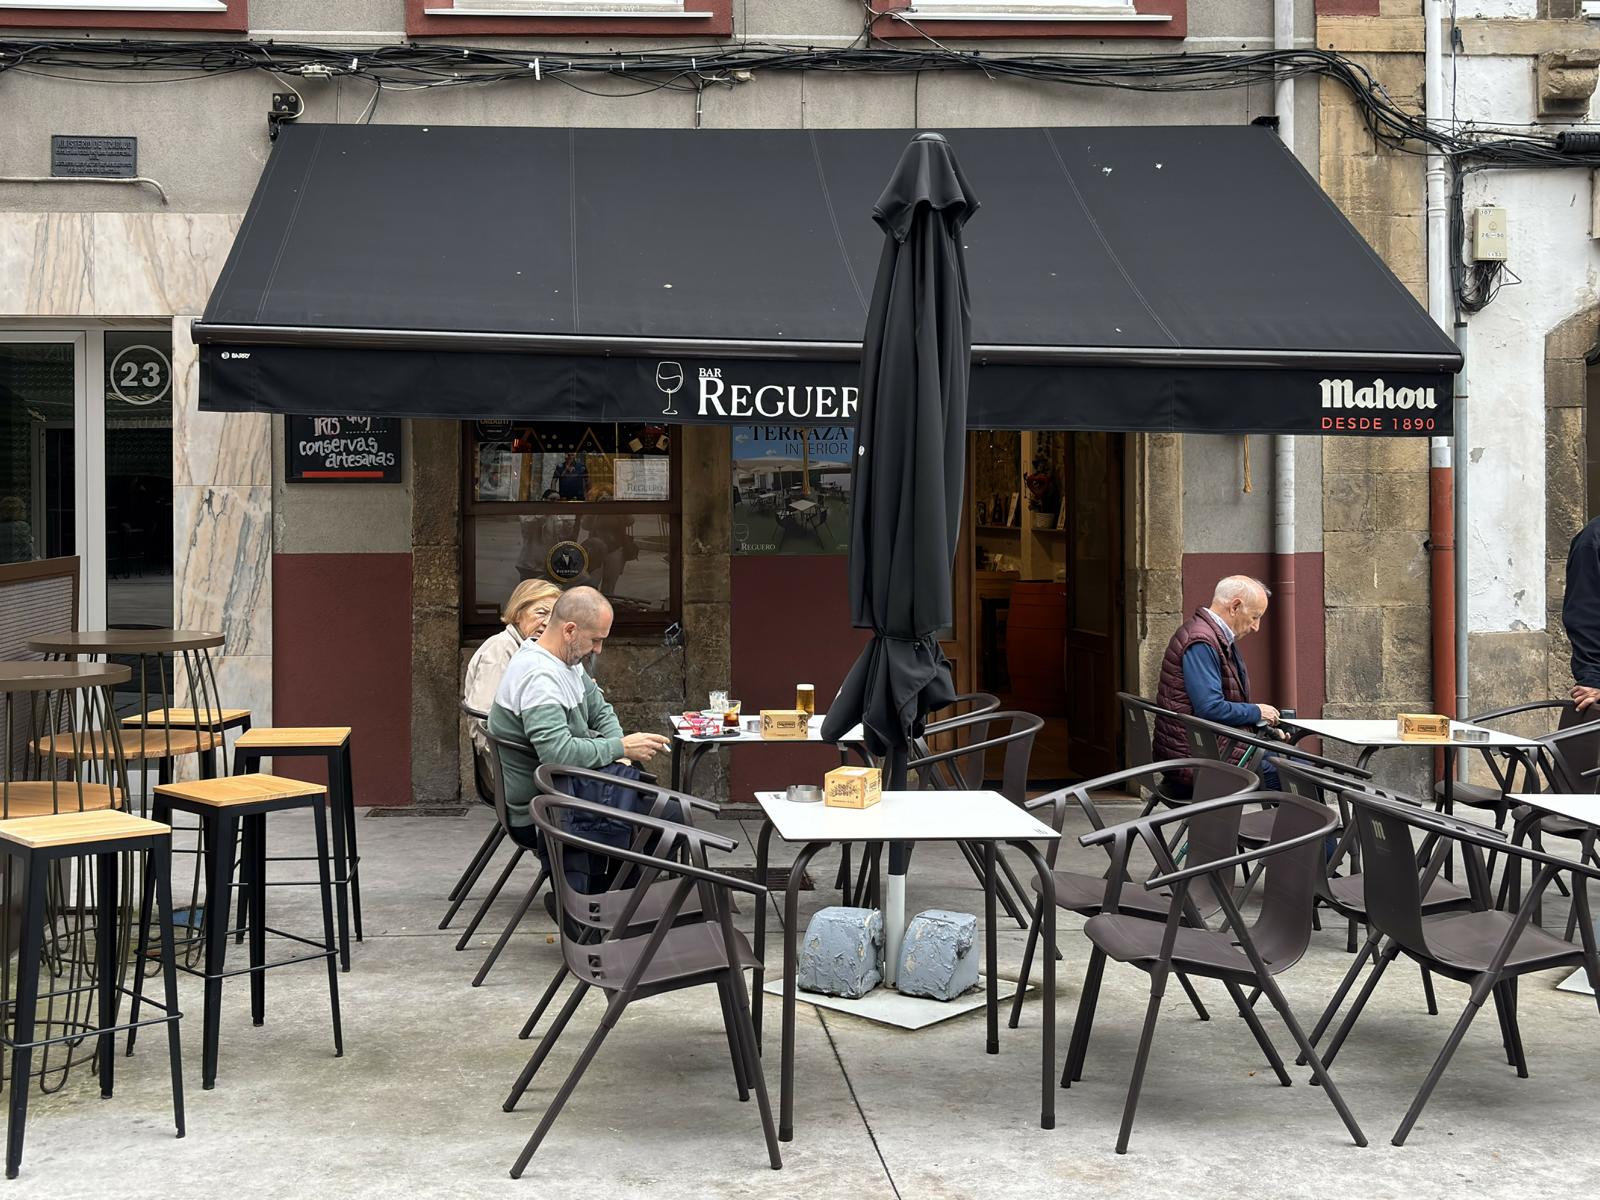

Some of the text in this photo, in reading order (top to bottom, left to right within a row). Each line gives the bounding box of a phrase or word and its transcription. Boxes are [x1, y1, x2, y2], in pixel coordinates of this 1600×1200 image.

[120, 361, 161, 387] 23
[698, 367, 722, 378] BAR
[697, 377, 859, 417] REGUER
[1318, 378, 1438, 409] Mahou
[1321, 417, 1436, 430] DESDE 1890
[299, 437, 378, 457] conservas
[785, 442, 848, 455] INERIOR
[324, 452, 395, 468] artesanas
[741, 543, 776, 551] REGUERO
